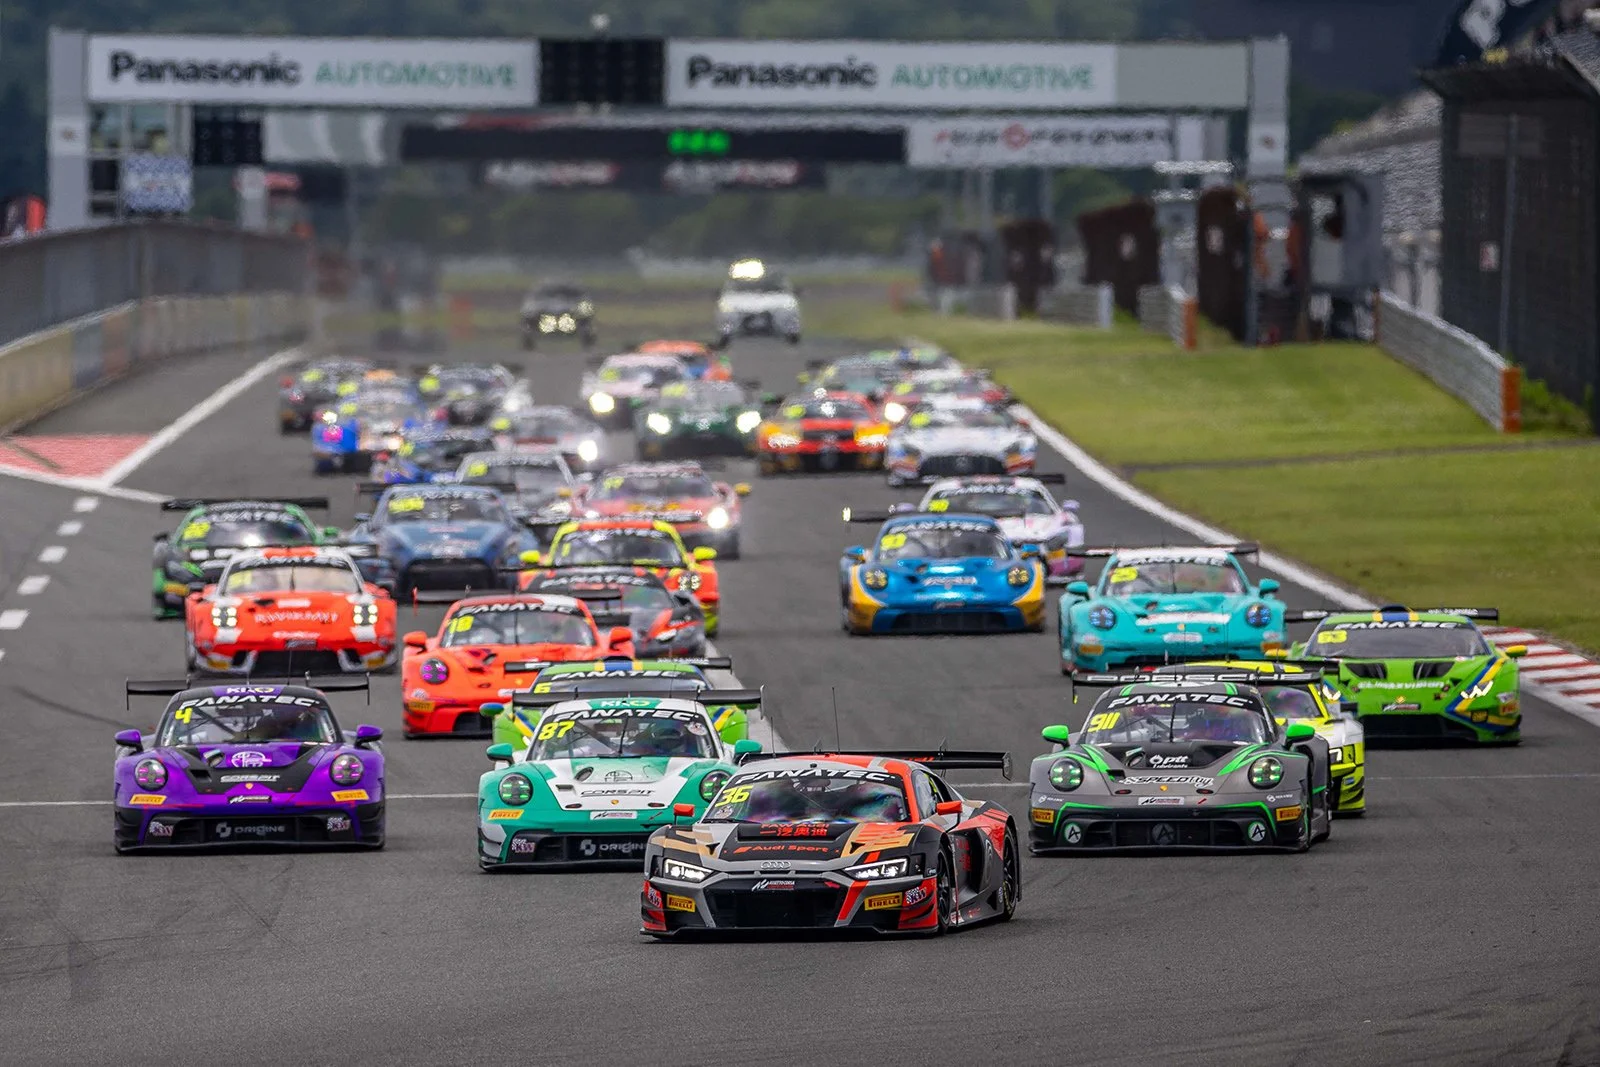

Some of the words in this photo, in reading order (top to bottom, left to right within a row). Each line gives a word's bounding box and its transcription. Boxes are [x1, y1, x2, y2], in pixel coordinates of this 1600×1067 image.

[110, 50, 301, 85] Panasonic
[315, 61, 517, 88] AUTOMOTIVE
[687, 54, 878, 89] Panasonic
[892, 63, 1094, 90] AUTOMOTIVE
[551, 670, 683, 681] FANATEC
[179, 695, 320, 710] FANATEC
[1107, 693, 1253, 709] FANATEC
[175, 707, 193, 724] 4
[552, 708, 700, 723] FANATEC
[1087, 712, 1121, 733] 911
[538, 720, 575, 741] 87
[734, 769, 897, 785] FANATEC
[715, 785, 754, 807] 36
[788, 845, 829, 853] Sport
[869, 896, 900, 908] PIRELLI
